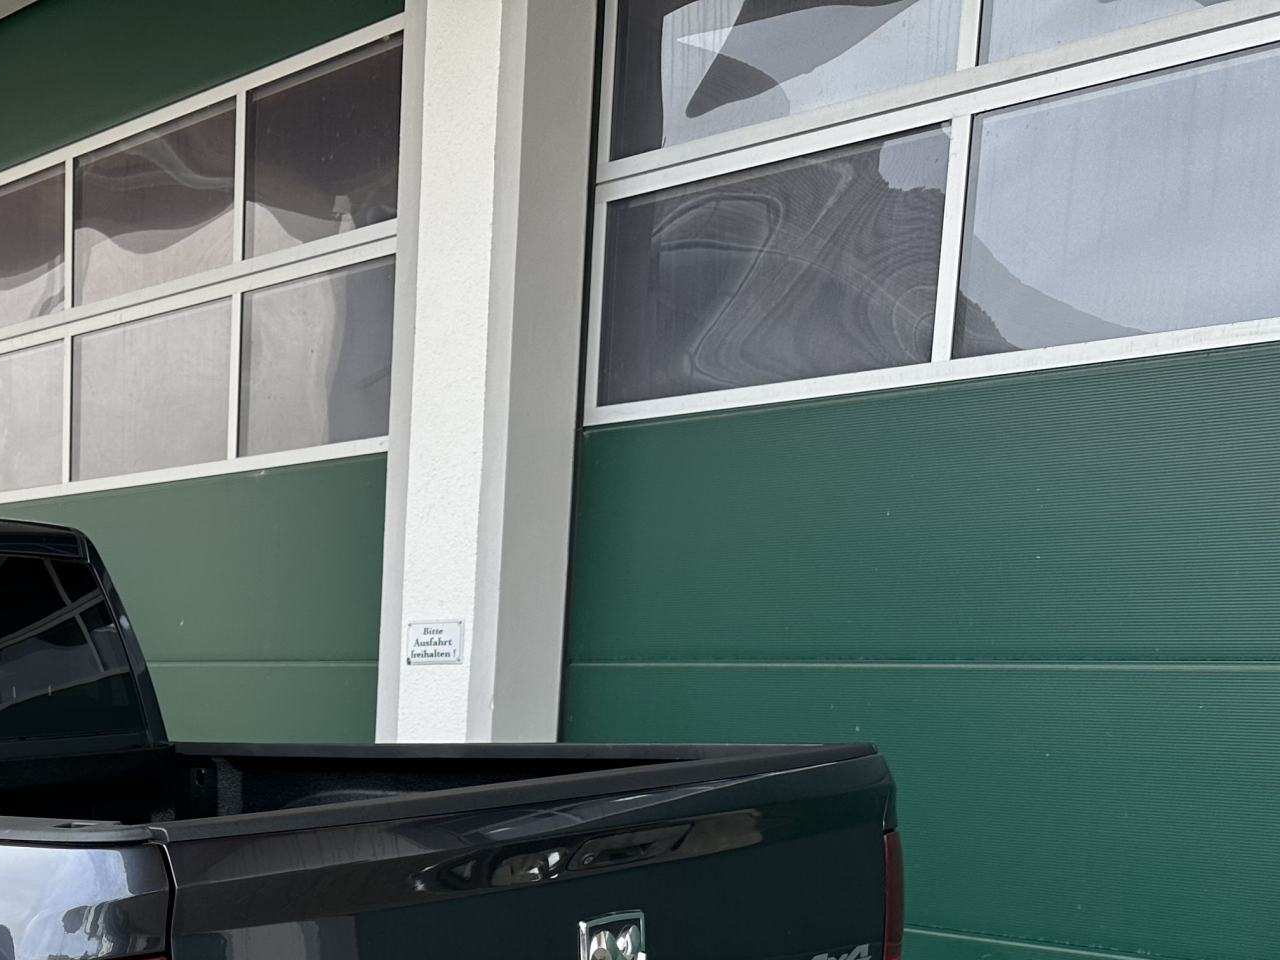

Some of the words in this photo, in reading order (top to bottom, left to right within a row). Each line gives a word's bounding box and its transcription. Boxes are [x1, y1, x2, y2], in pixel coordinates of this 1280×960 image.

[423, 627, 443, 636] Bitte
[413, 637, 452, 647] Ausfahrt
[410, 649, 451, 659] freihalten
